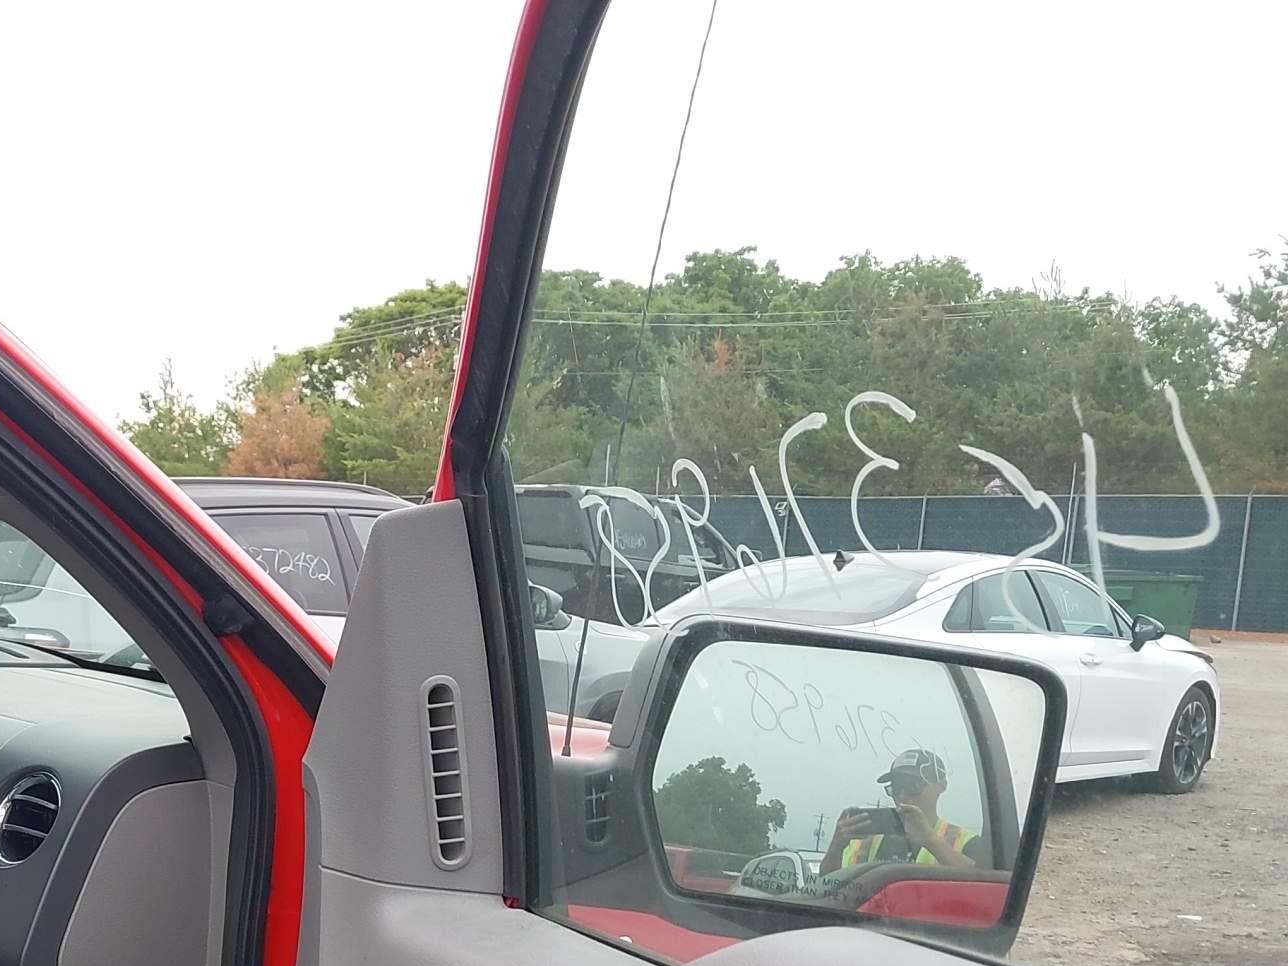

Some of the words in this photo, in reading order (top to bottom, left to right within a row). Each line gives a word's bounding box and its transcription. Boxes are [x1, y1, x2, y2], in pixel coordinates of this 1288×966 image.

[753, 863, 800, 881] OBJECTS
[805, 874, 817, 885] IN
[791, 883, 817, 897] THAN
